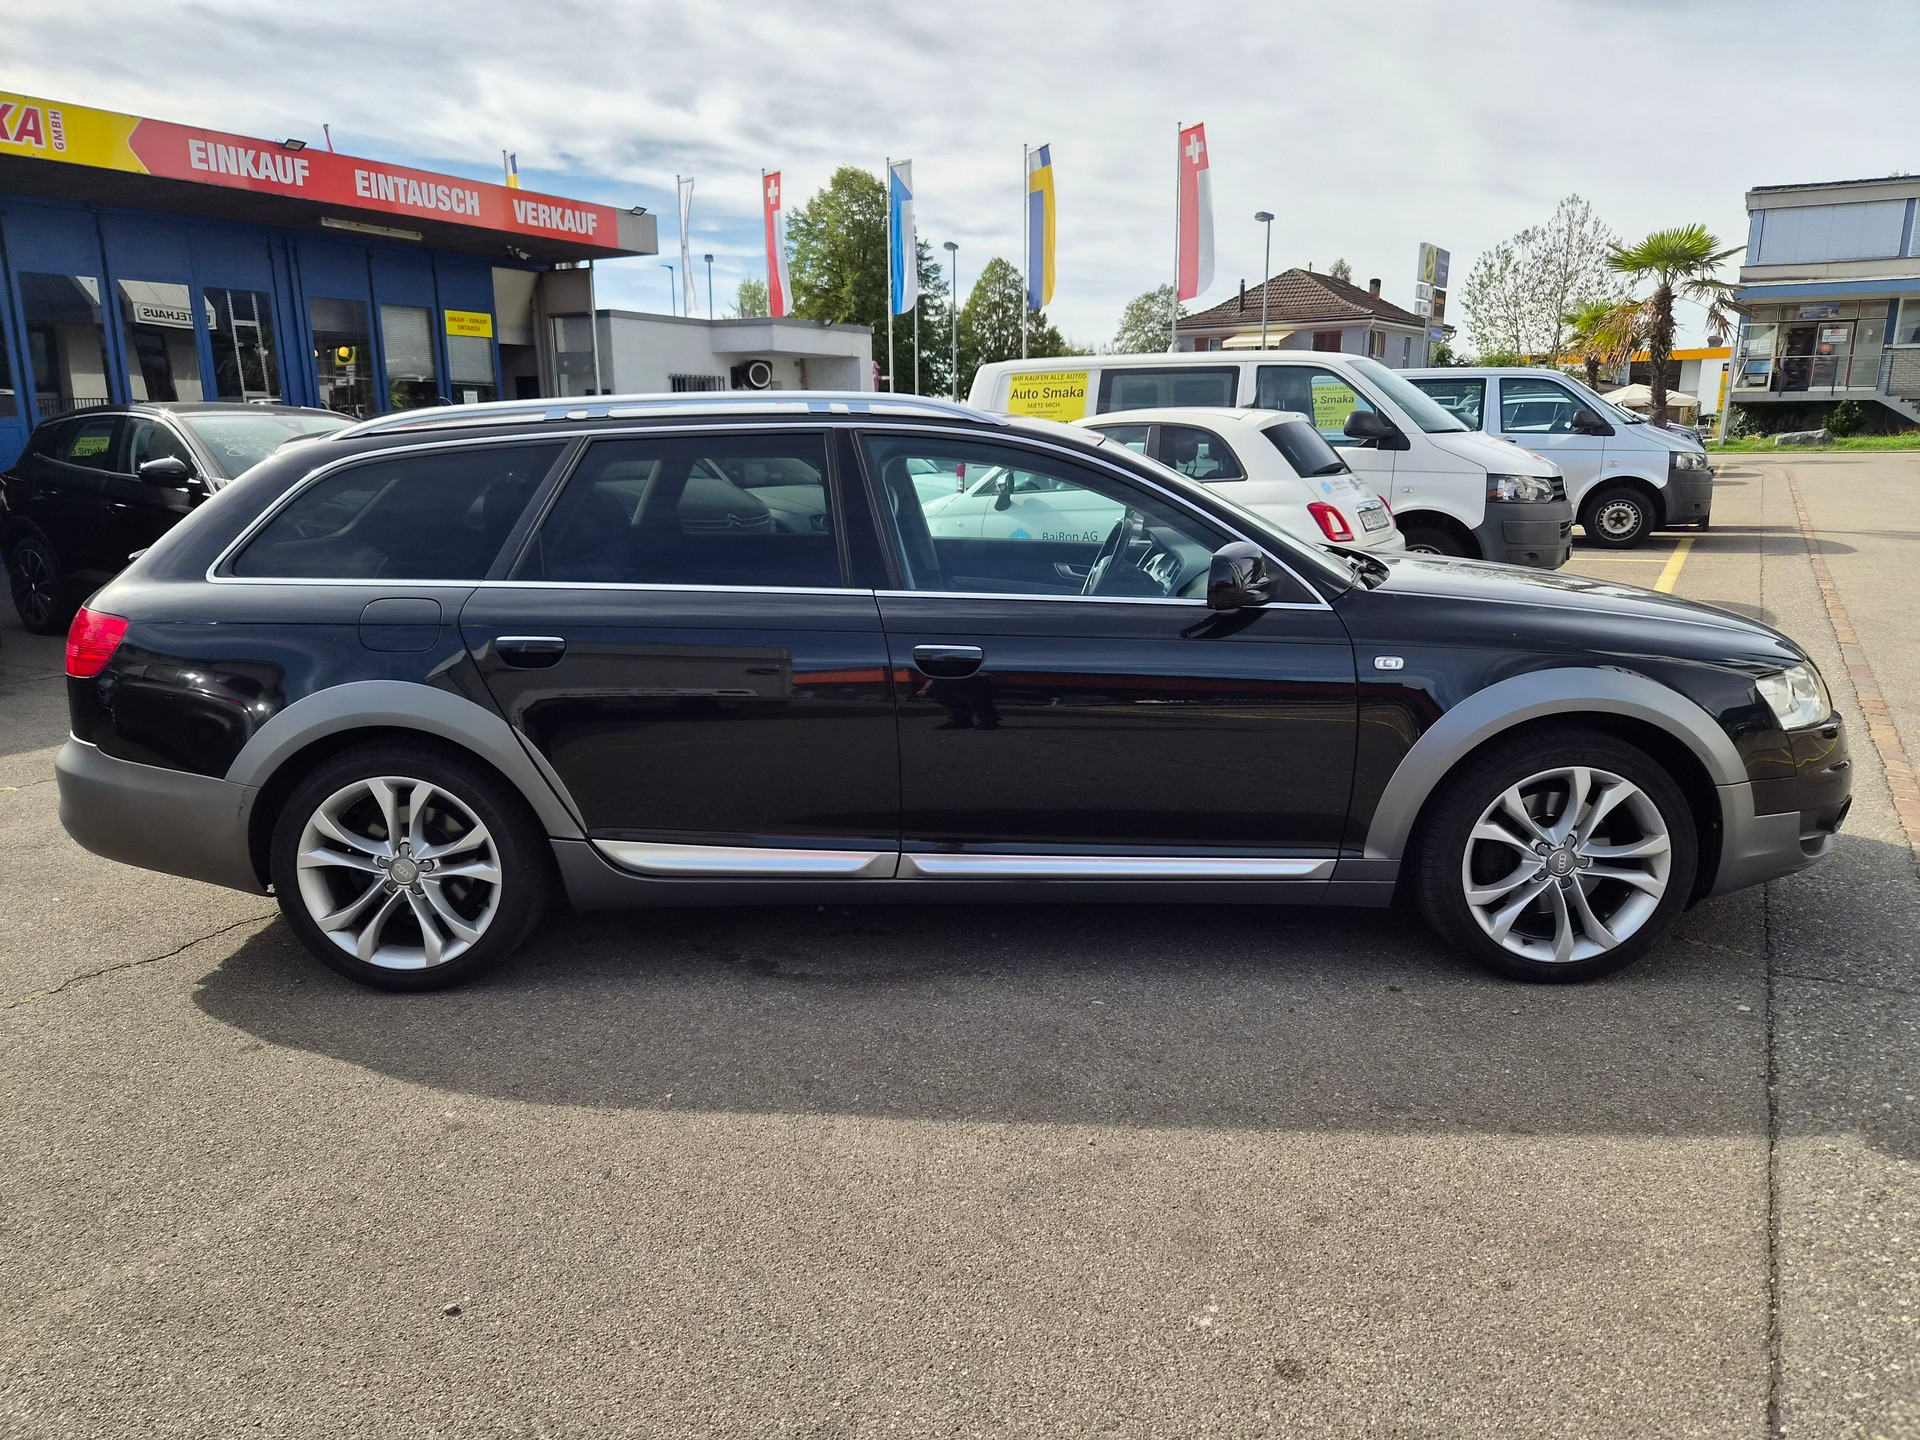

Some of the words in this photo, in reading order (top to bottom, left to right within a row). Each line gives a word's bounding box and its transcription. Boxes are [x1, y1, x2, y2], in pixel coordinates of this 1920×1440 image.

[49, 110, 65, 151] GMBH
[188, 138, 310, 187] EINKAUF
[354, 169, 480, 217] EINTAUSCH
[512, 198, 597, 236] VERKAUF
[1024, 374, 1049, 382] KAUFEN
[1050, 373, 1065, 381] ALLE
[1066, 372, 1087, 380] AUTOS
[1011, 388, 1039, 400] Auto
[1042, 386, 1084, 399] Smaka
[1320, 395, 1354, 404] Smaka
[1042, 531, 1079, 541] BaiRon
[1082, 530, 1098, 542] AG
